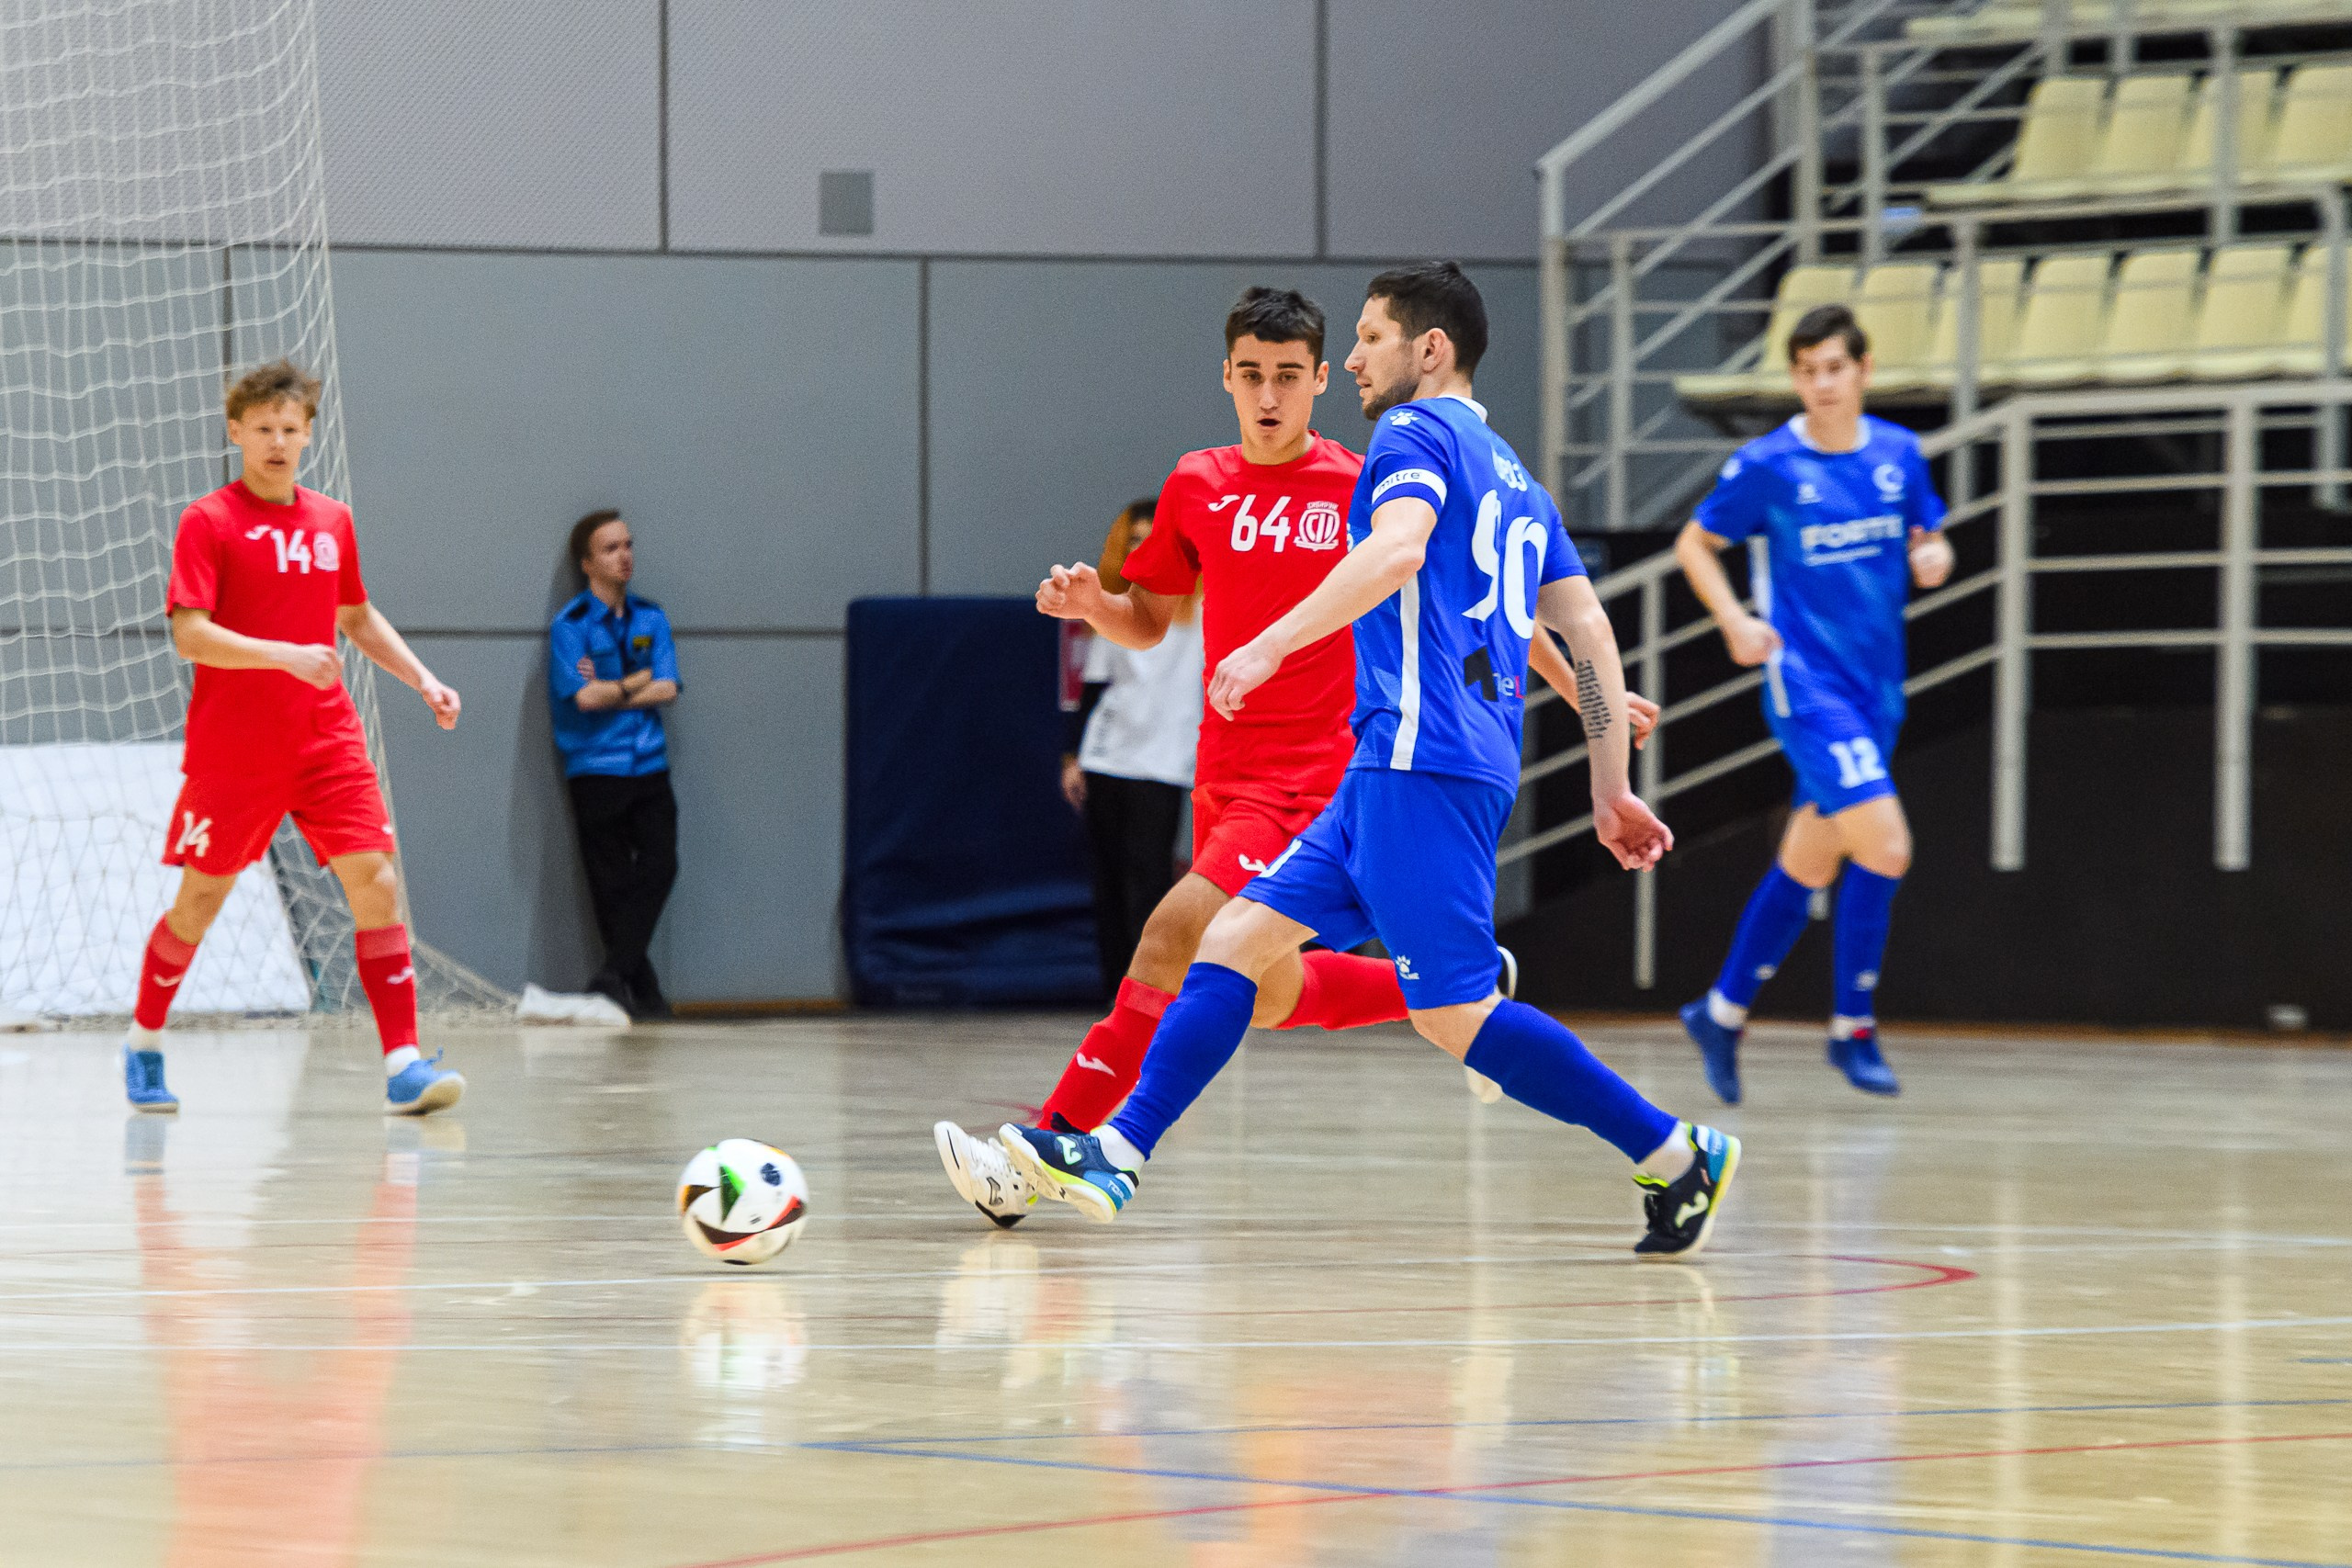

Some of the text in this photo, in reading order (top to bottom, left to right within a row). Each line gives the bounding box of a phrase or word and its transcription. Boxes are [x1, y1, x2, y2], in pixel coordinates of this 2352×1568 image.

[1378, 471, 1421, 493] mitre
[1231, 494, 1292, 553] 64
[270, 528, 311, 574] 14
[1461, 489, 1548, 639] 90
[1828, 736, 1887, 789] 12
[175, 811, 212, 858] 14
